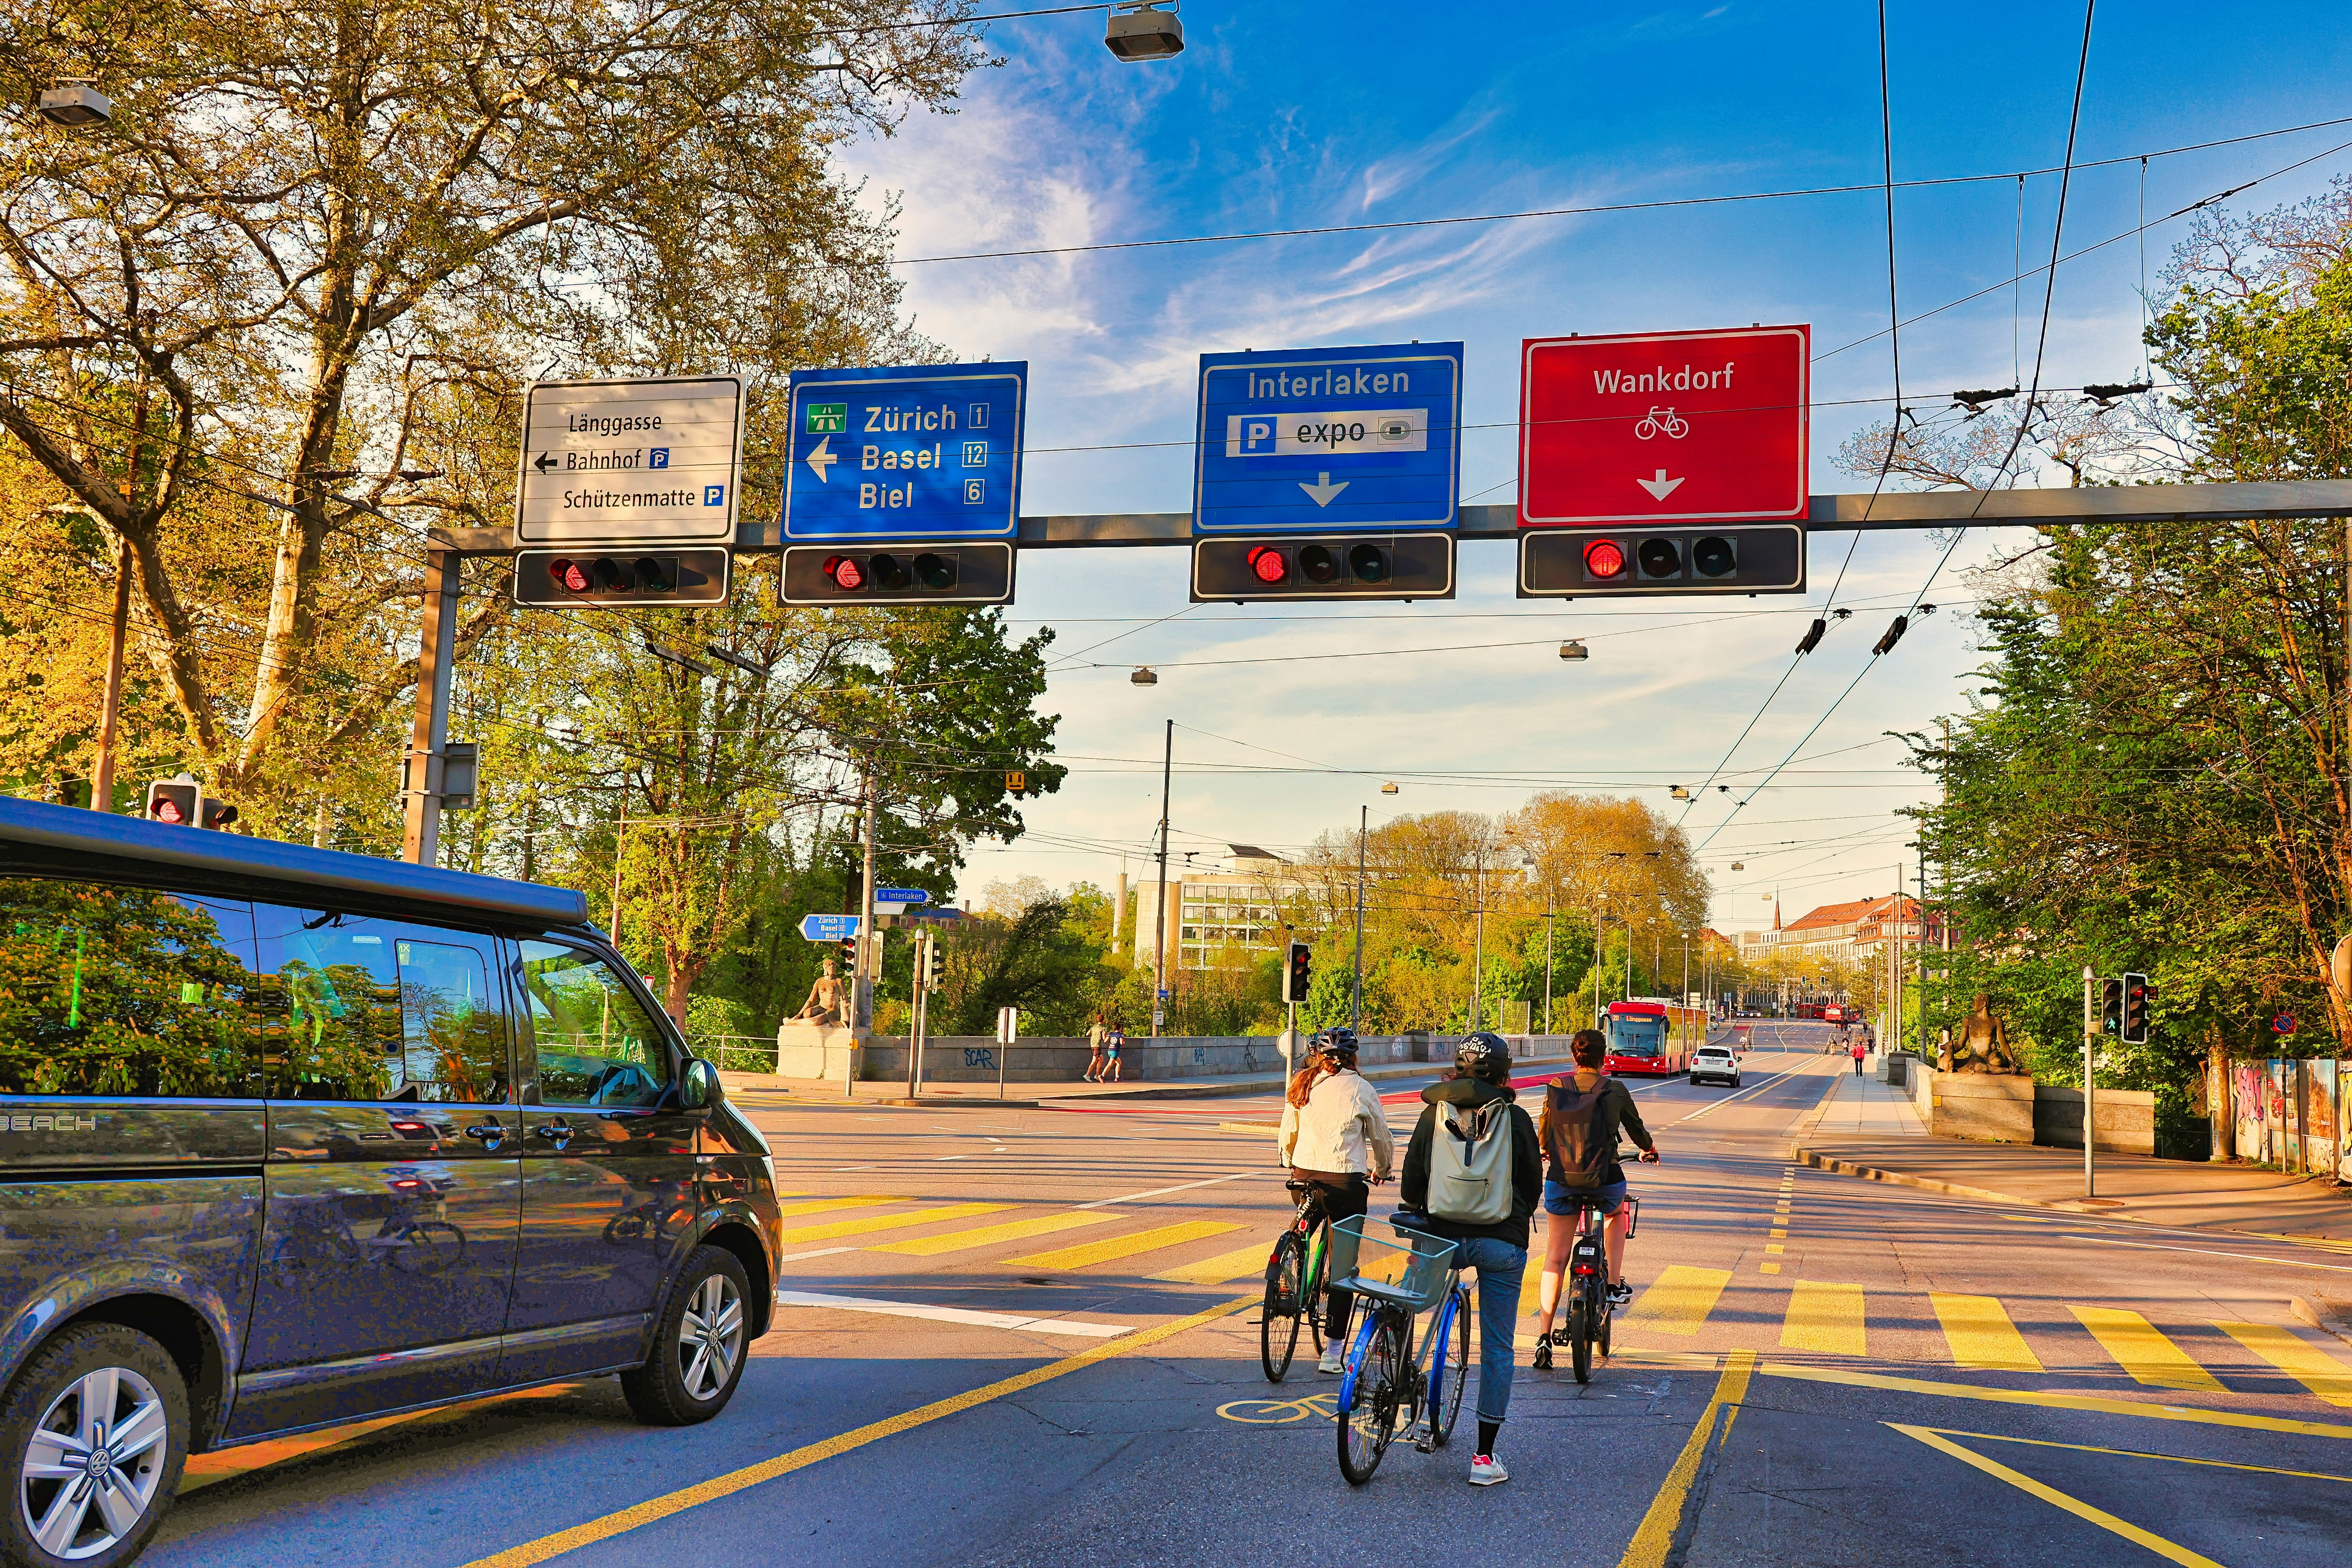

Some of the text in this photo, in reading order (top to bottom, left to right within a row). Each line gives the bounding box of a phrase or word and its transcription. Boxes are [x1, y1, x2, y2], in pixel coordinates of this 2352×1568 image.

[1249, 368, 1408, 398] Interlaken
[1594, 362, 1734, 394] Wankdorf
[570, 414, 661, 436] Länggasse
[864, 405, 981, 432] Zürich 1
[1249, 422, 1365, 449] P expo
[568, 449, 641, 469] Bahnhof
[862, 443, 982, 470] Basel 12
[564, 489, 720, 508] Schützenmatte P
[860, 483, 980, 508] Biel 6
[965, 1049, 998, 1069] SCAR
